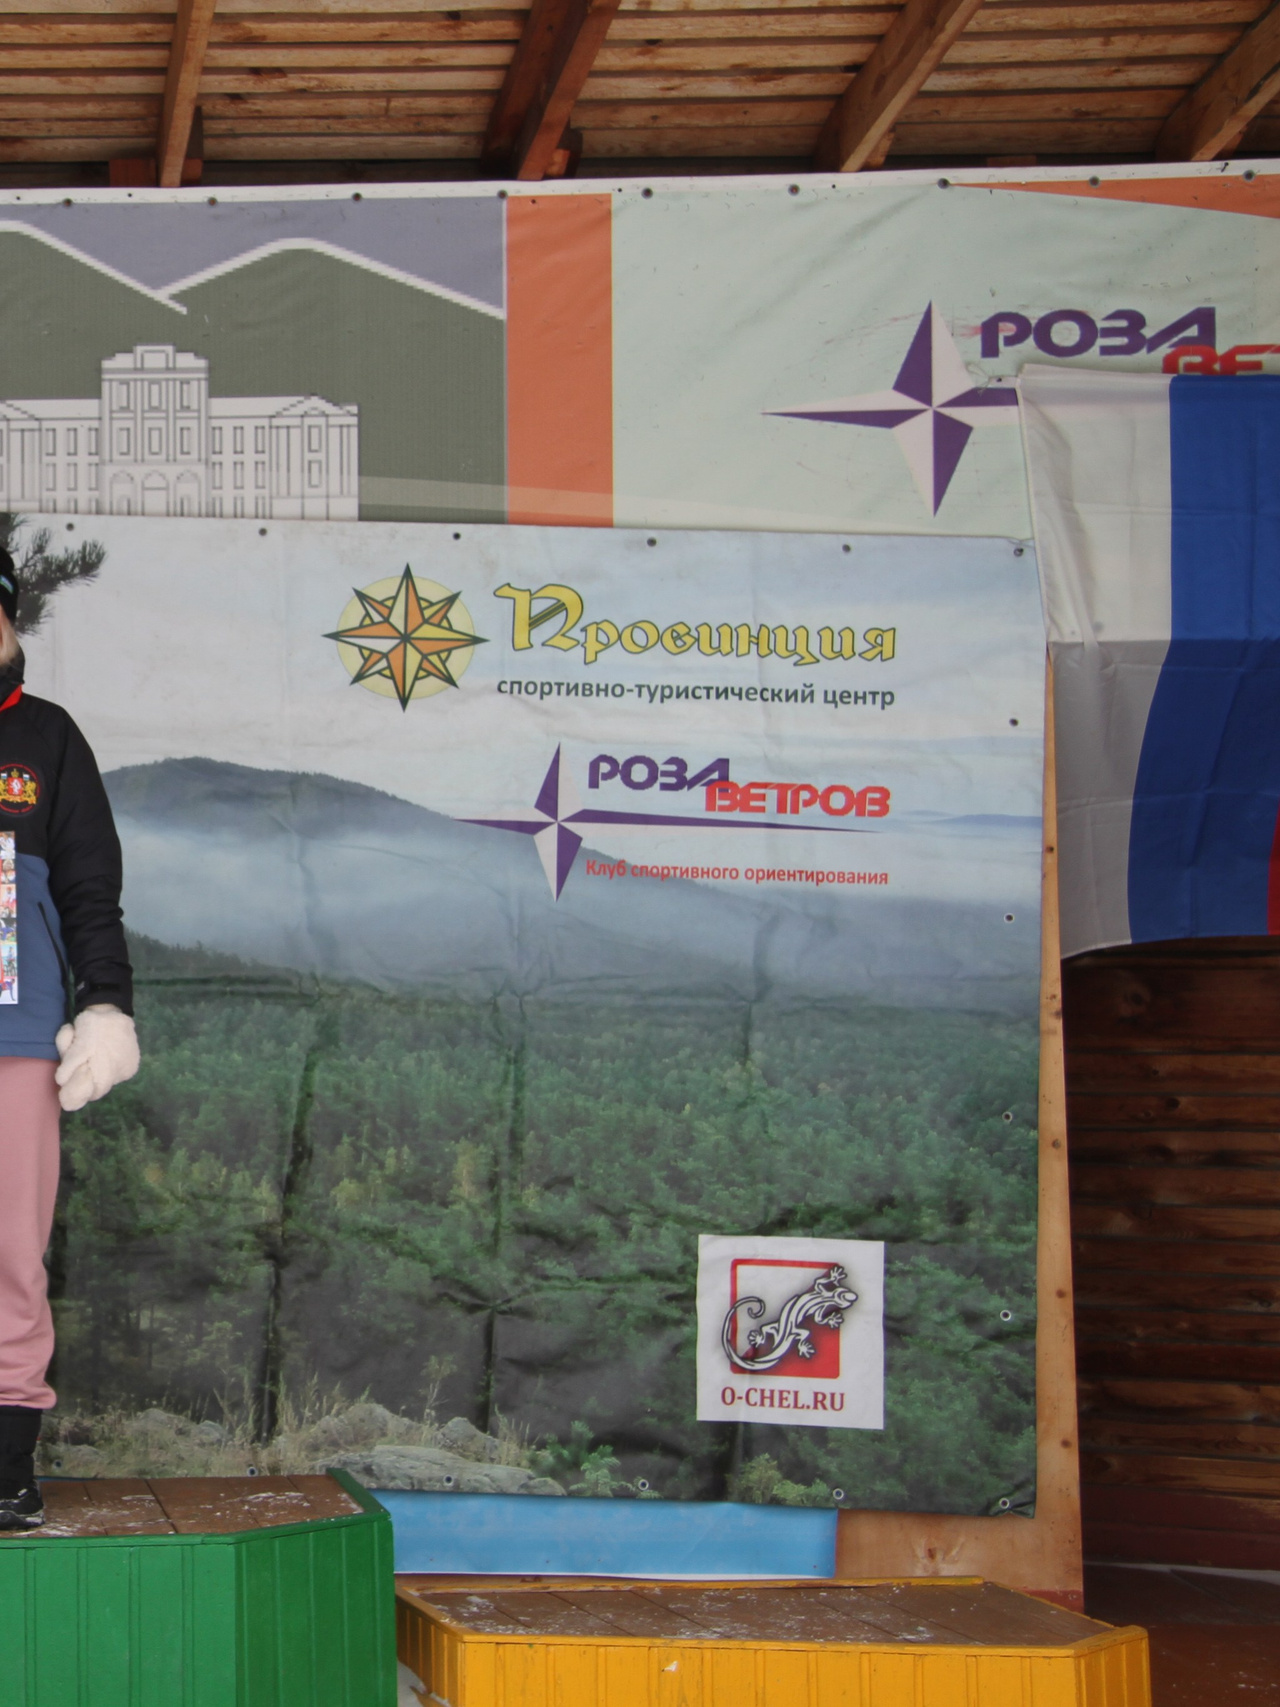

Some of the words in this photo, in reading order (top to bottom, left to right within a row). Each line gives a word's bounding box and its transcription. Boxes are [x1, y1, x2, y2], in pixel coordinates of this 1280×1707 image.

[980, 306, 1216, 359] РОЗА
[493, 583, 896, 666] Провинция
[497, 677, 815, 704] спортивно-туристический
[823, 687, 896, 711] центр
[588, 753, 730, 793] РОЗА
[705, 781, 891, 818] ВЕТРОВ
[585, 859, 627, 880] Клуб
[631, 862, 739, 883] спортивного
[744, 867, 889, 887] ориентирования
[721, 1386, 846, 1412] O-CHEL.RU
